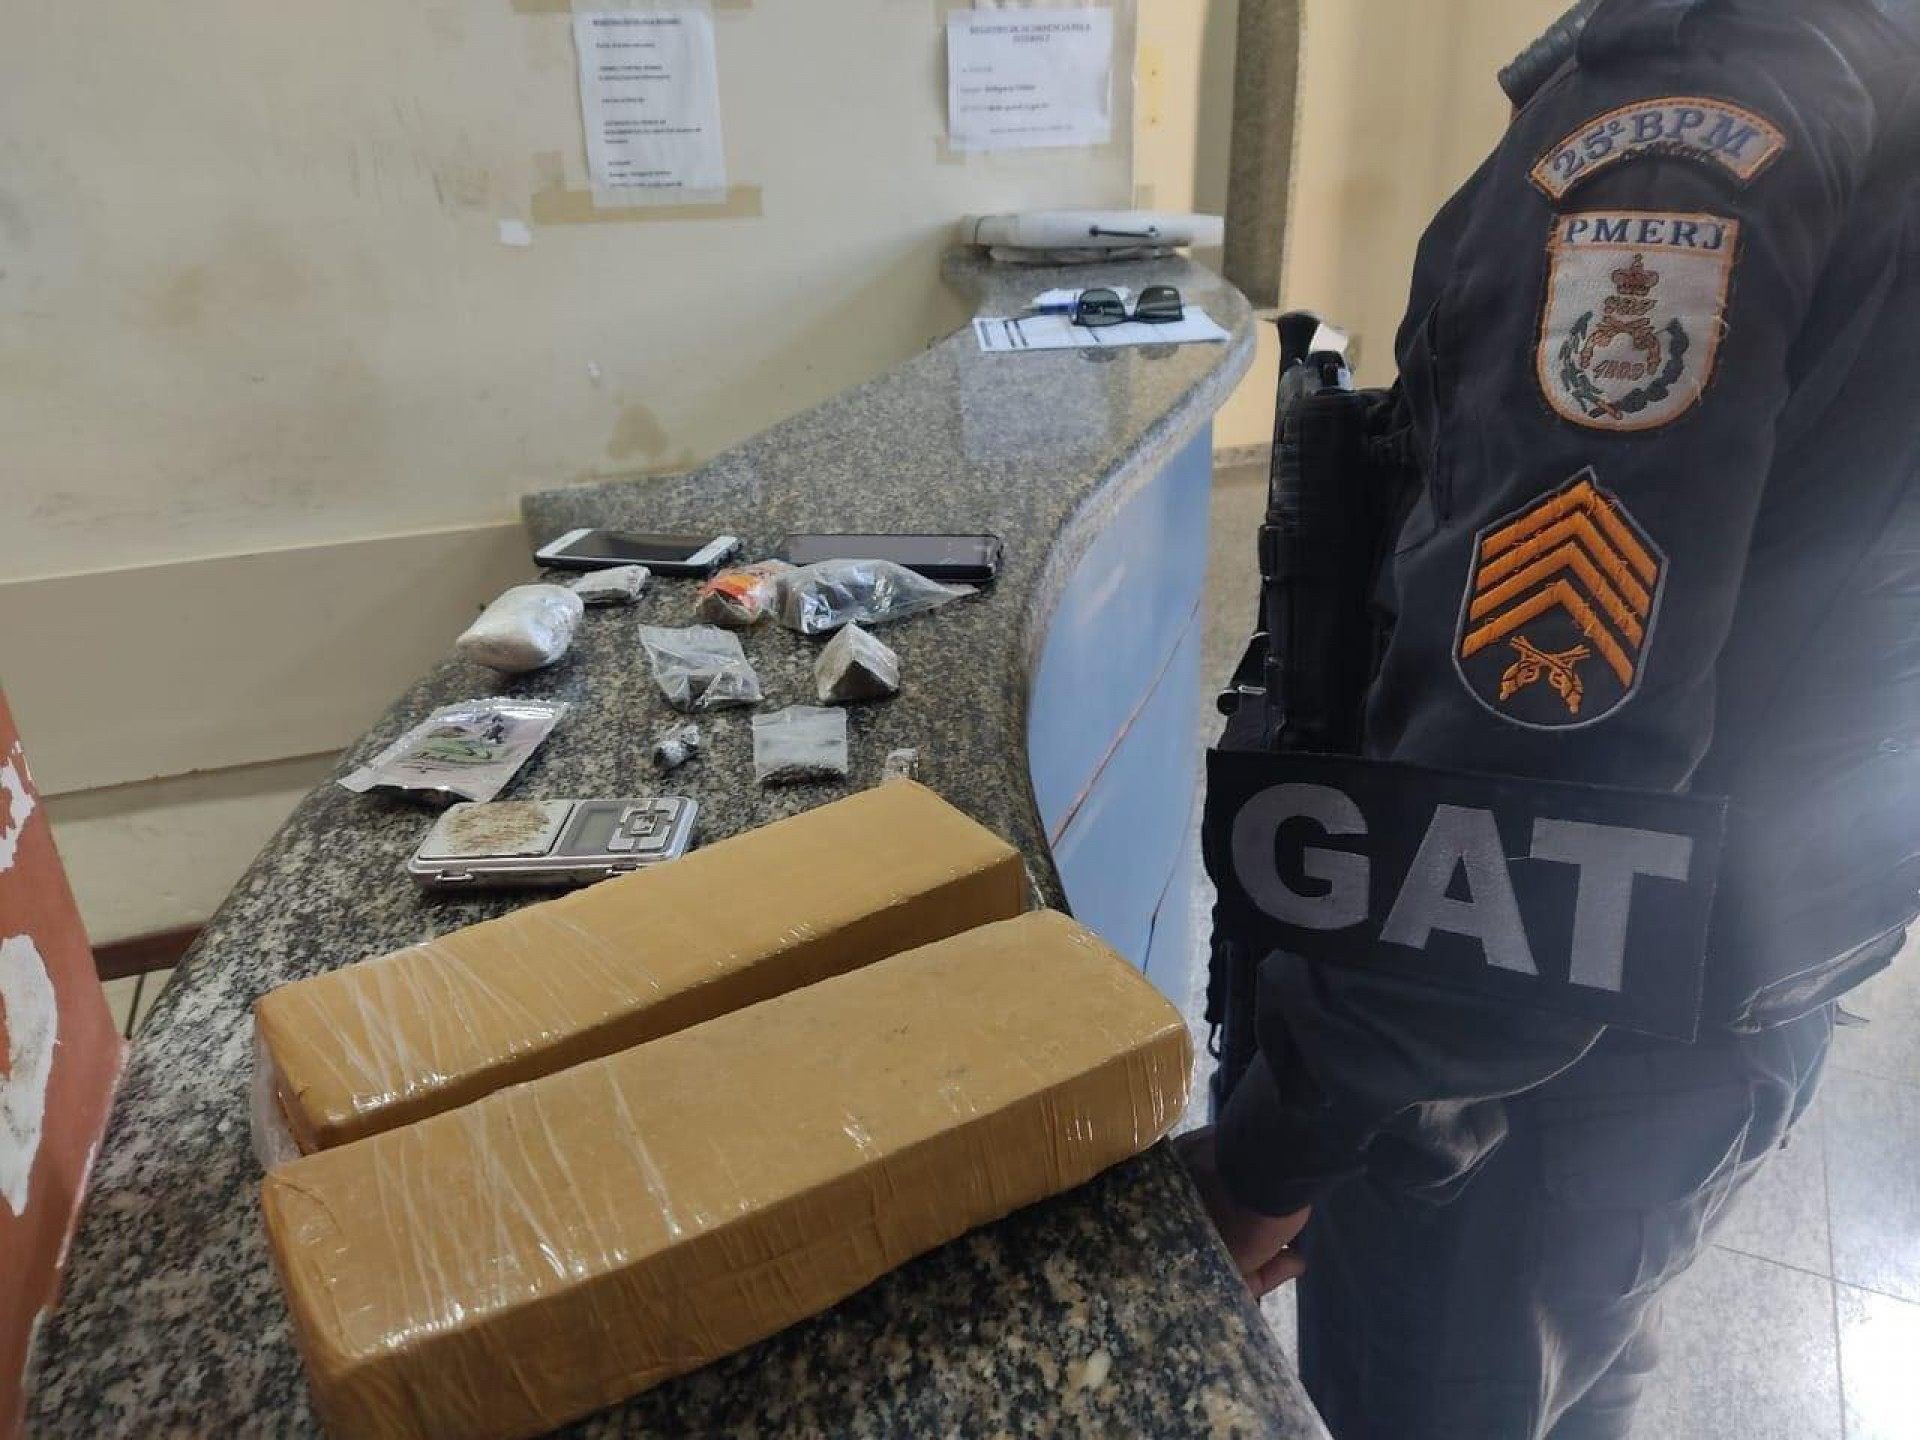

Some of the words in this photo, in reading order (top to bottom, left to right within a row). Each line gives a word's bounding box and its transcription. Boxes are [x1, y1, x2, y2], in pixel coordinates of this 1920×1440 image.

[1630, 107, 1761, 157] BPM
[1563, 218, 1726, 250] PMERJ
[1231, 782, 1694, 992] GAT
